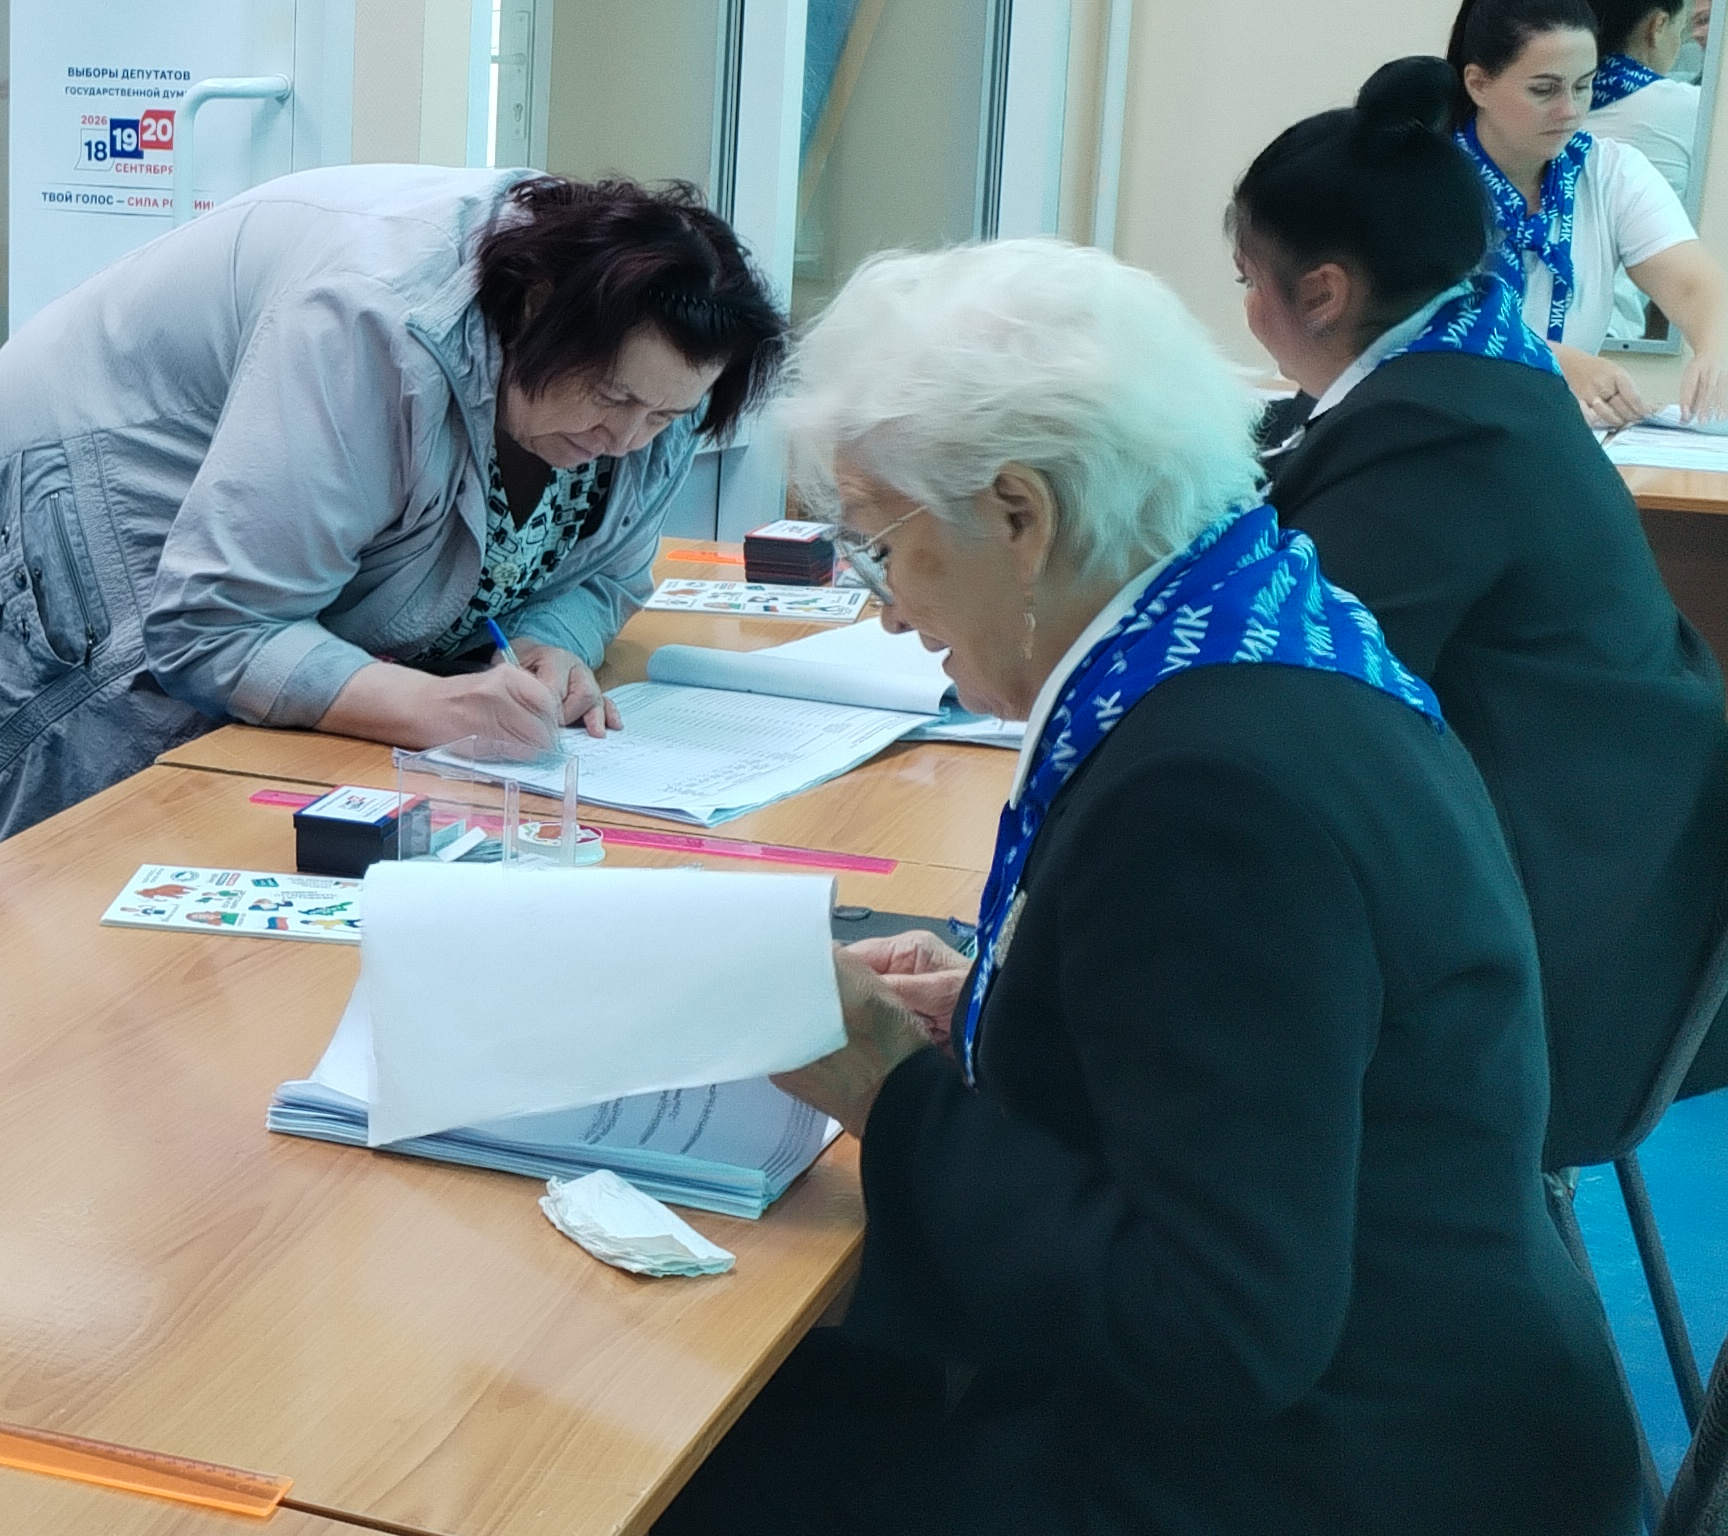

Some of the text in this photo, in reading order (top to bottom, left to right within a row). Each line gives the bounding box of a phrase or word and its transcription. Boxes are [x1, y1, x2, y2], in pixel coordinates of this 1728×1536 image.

[68, 67, 191, 81] ВЫБОРЫ ДЕПУТАТОВ
[65, 85, 187, 99] ГОСУДАРСТВЕННОЙ ДУМ
[81, 115, 108, 125] 2026
[84, 117, 173, 162] 18 19 20
[42, 191, 72, 204] ТВОЙ
[75, 194, 114, 205] ГОЛОС
[127, 197, 159, 208] СИЛА
[1563, 172, 1575, 200] УИК
[1560, 214, 1572, 242] УИК
[1550, 300, 1565, 328] УИК
[1157, 604, 1213, 677] УИК
